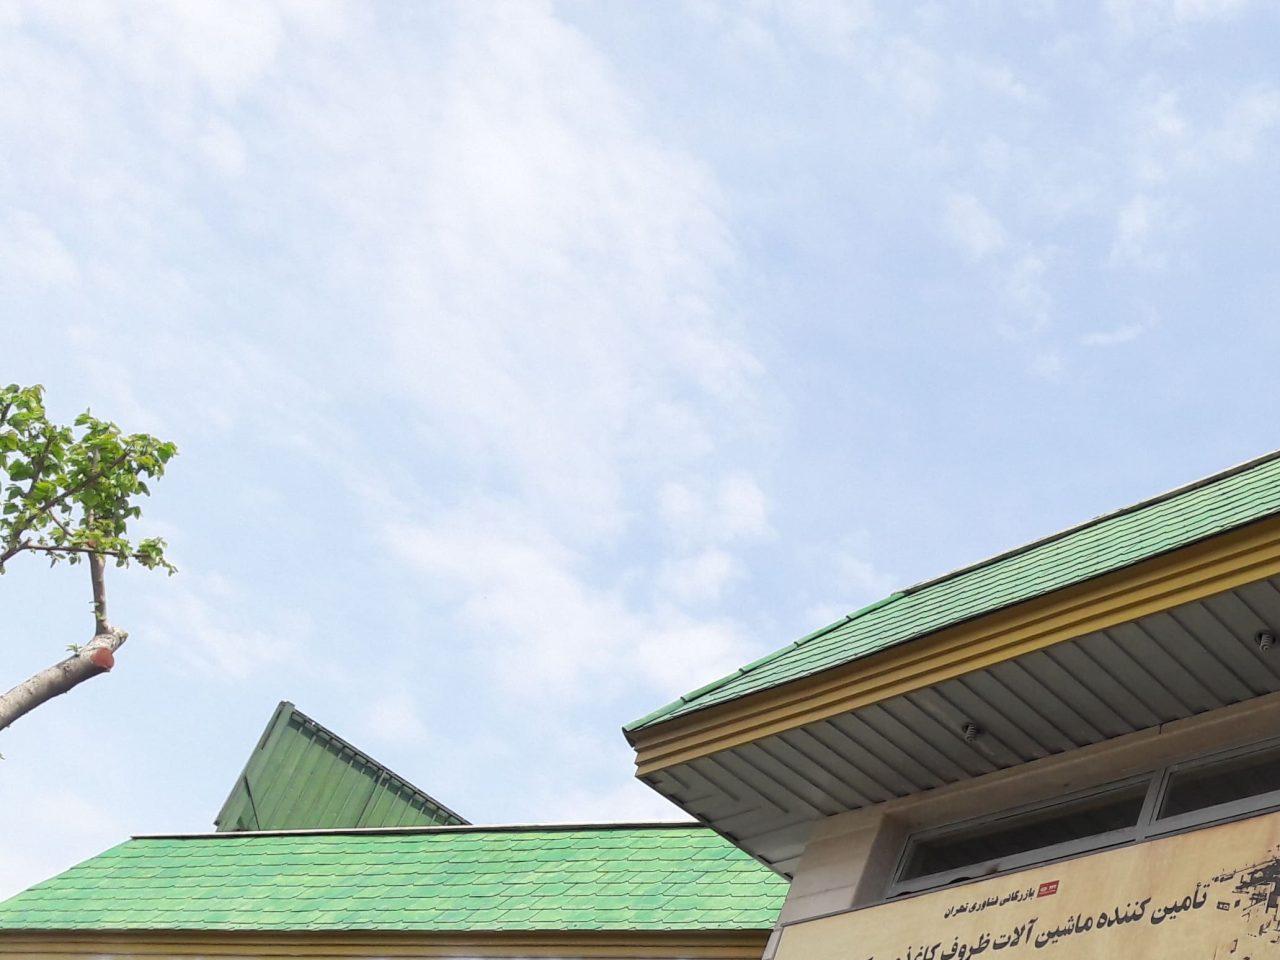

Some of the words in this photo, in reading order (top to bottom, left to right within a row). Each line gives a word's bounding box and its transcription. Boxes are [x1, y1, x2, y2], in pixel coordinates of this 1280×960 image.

[1096, 897, 1152, 929] کننده
[992, 917, 1039, 951] آلات
[1035, 913, 1094, 949] ماشین
